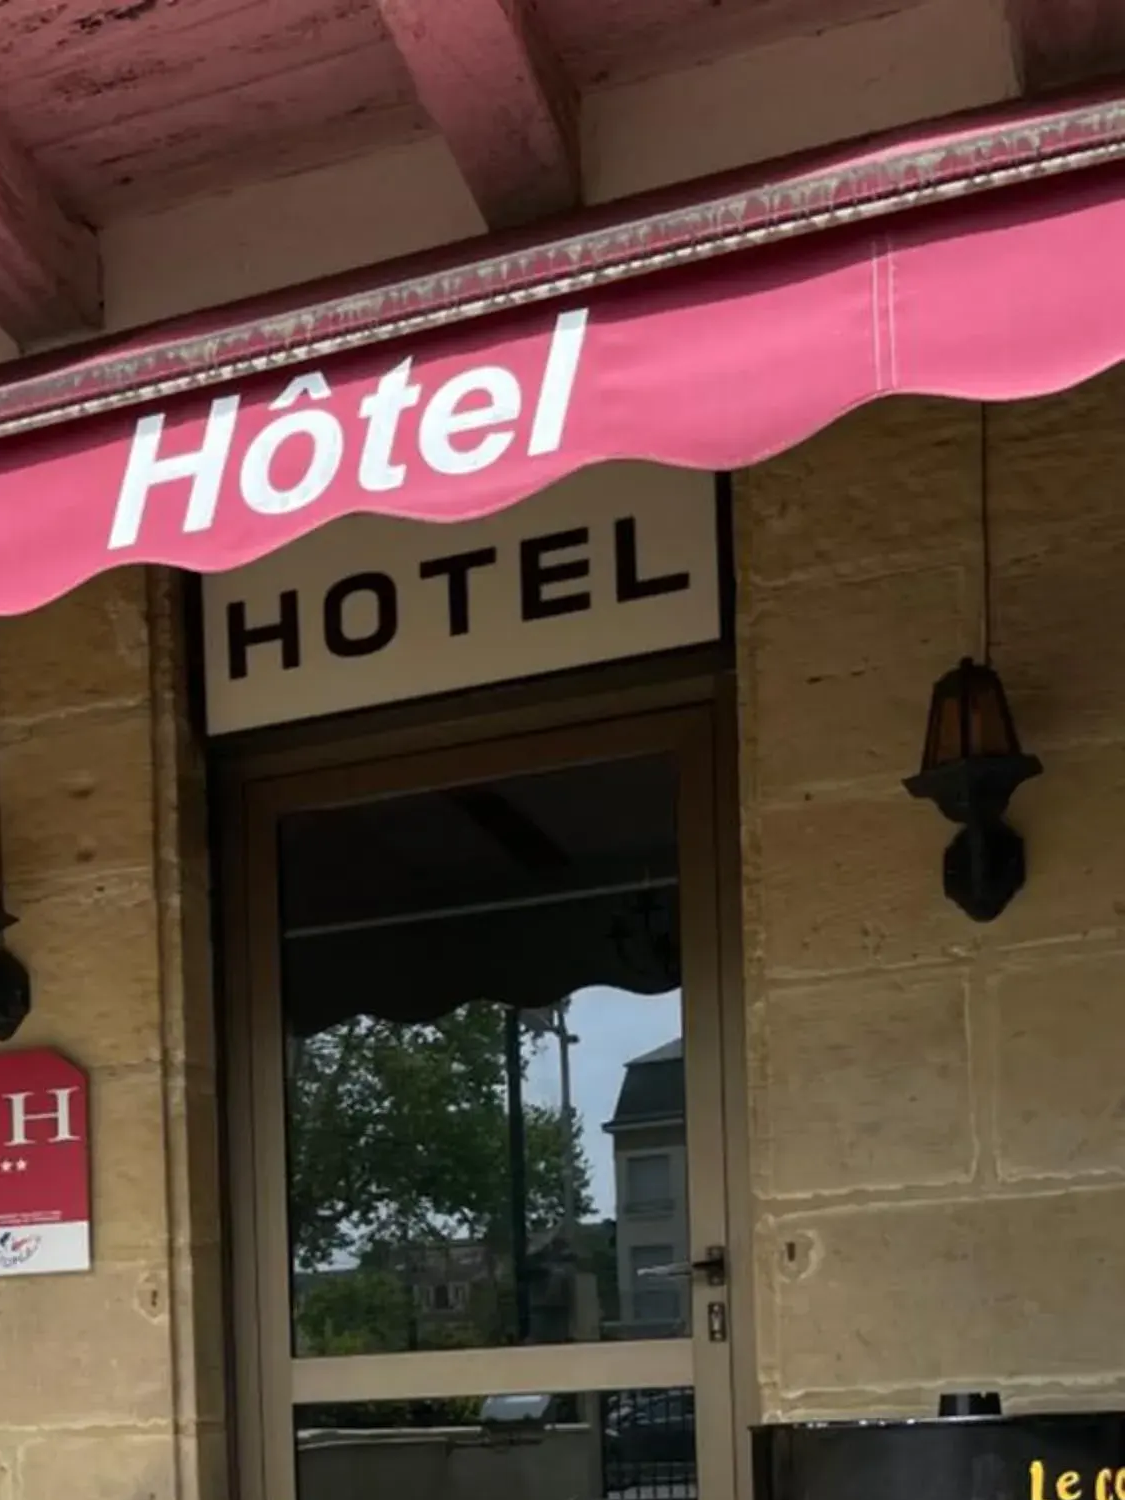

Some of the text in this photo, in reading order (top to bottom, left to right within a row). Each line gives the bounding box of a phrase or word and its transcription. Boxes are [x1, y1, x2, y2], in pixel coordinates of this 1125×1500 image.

[107, 307, 589, 551] Hôtel
[226, 516, 690, 681] HOTEL
[0, 1085, 82, 1147] H
